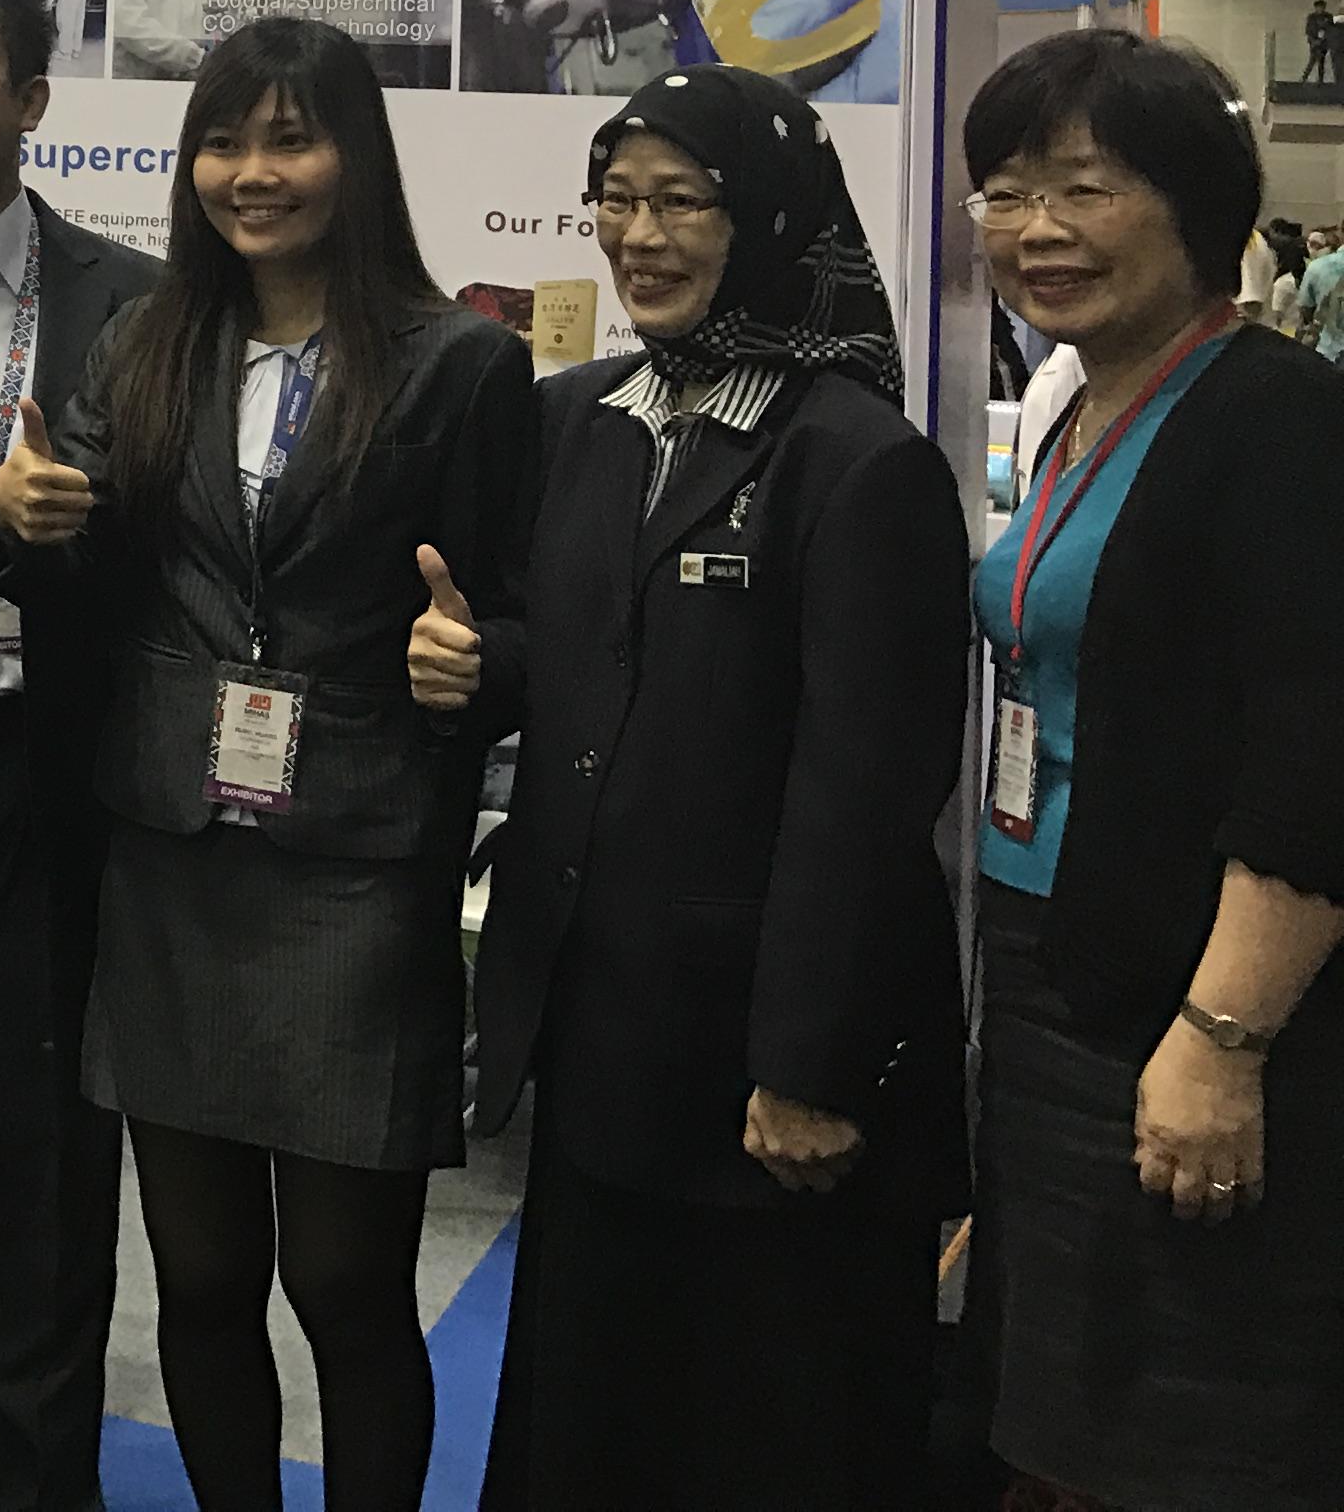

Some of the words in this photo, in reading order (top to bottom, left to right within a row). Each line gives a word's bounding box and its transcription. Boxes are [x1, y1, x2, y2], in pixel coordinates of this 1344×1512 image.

[89, 211, 172, 229] equipmen
[485, 210, 543, 235] Our
[220, 785, 274, 805] EXHIBITOR
